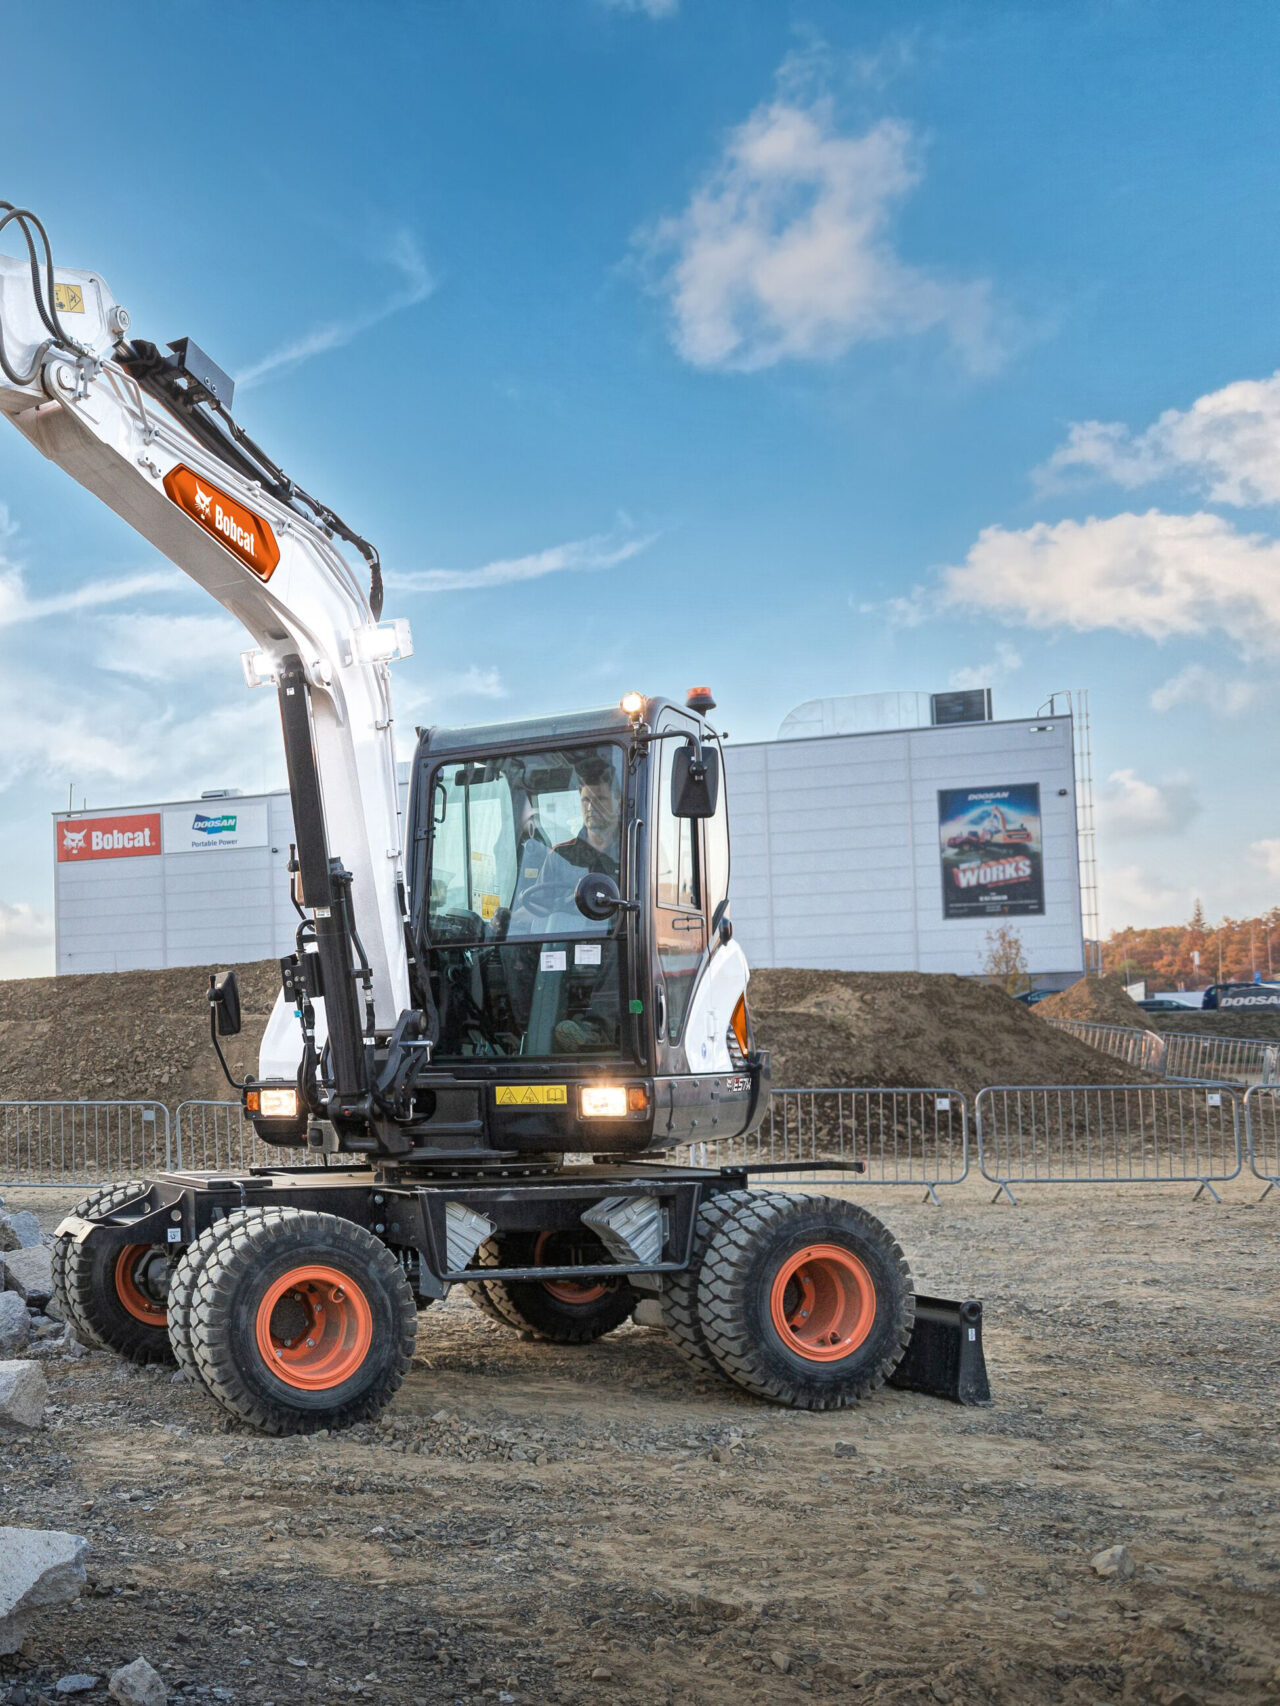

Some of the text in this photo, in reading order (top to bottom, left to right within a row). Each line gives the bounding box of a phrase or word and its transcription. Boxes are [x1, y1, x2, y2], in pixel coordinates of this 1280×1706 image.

[215, 504, 255, 556] Bobcat
[968, 792, 1009, 800] DOOSAN
[194, 819, 235, 828] DOOSAN
[91, 828, 151, 851] Bobcat
[191, 838, 238, 847] Portable Power
[958, 860, 1031, 888] WORKS
[1221, 996, 1280, 1006] DOOSA
